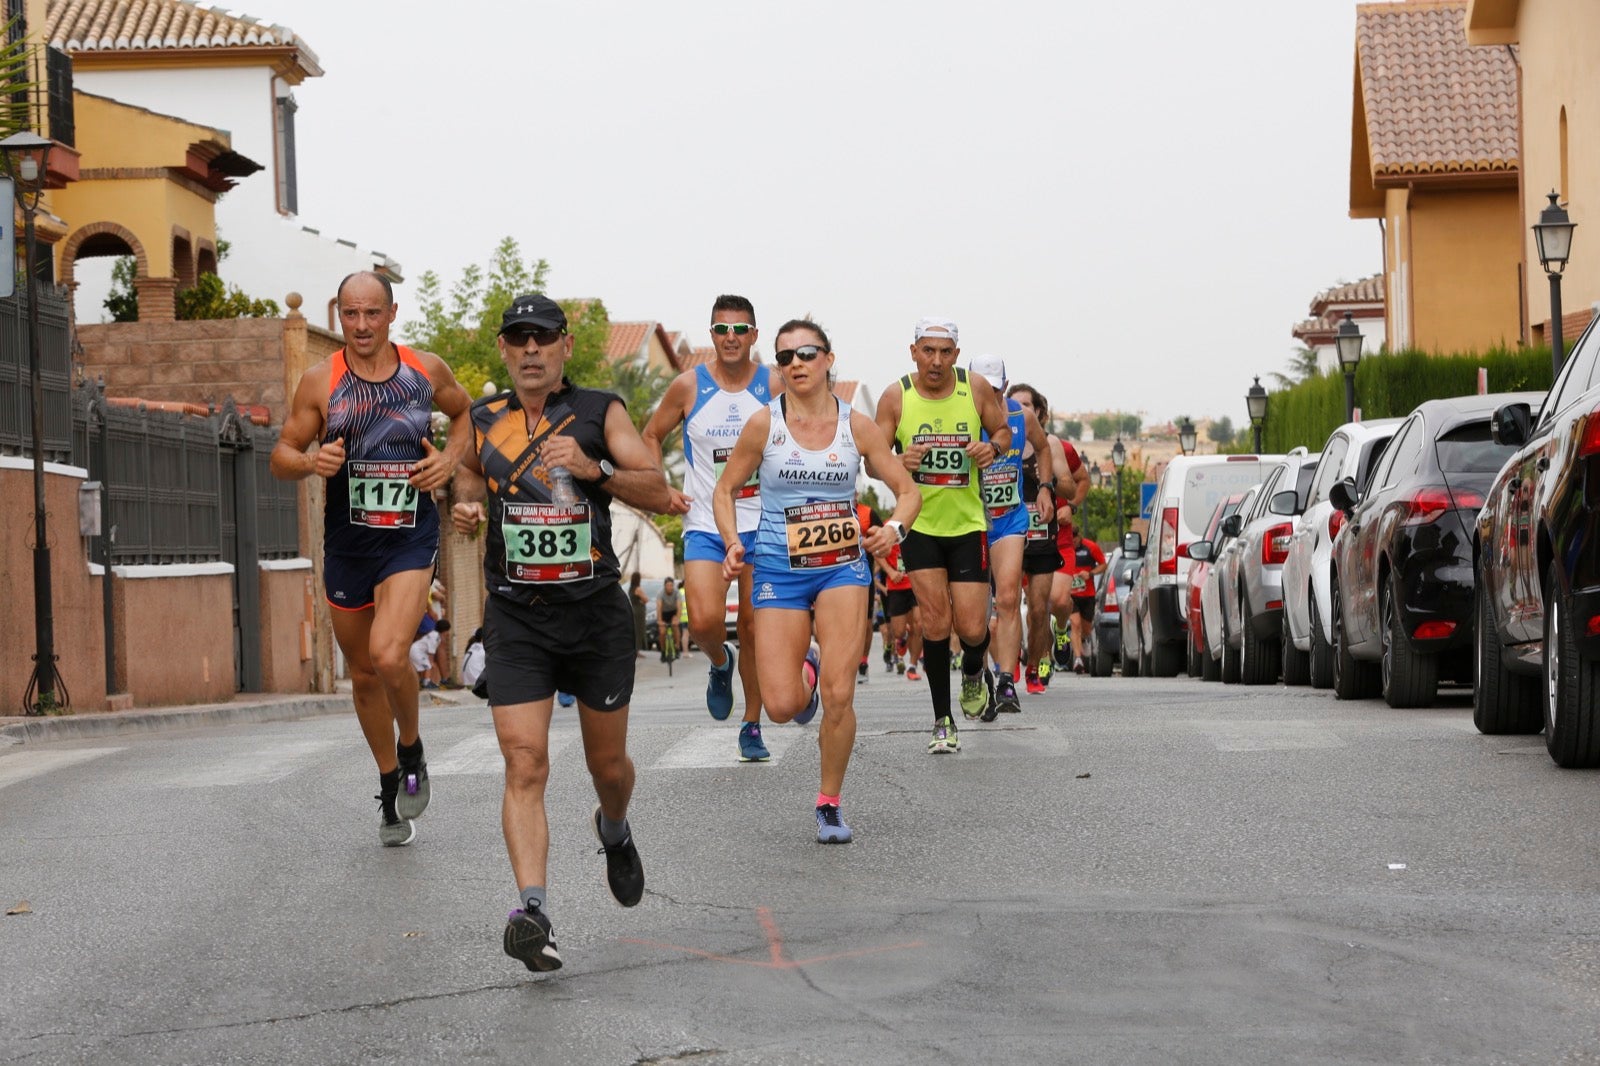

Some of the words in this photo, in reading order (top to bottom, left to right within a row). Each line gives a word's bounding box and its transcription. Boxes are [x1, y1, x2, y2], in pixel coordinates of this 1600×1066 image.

[705, 428, 741, 437] MARAC
[920, 450, 963, 470] 459
[778, 469, 849, 482] MARACENA
[354, 481, 416, 506] 1179
[538, 506, 557, 516] PREMI
[517, 529, 578, 558] 383
[797, 521, 856, 549] 2266
